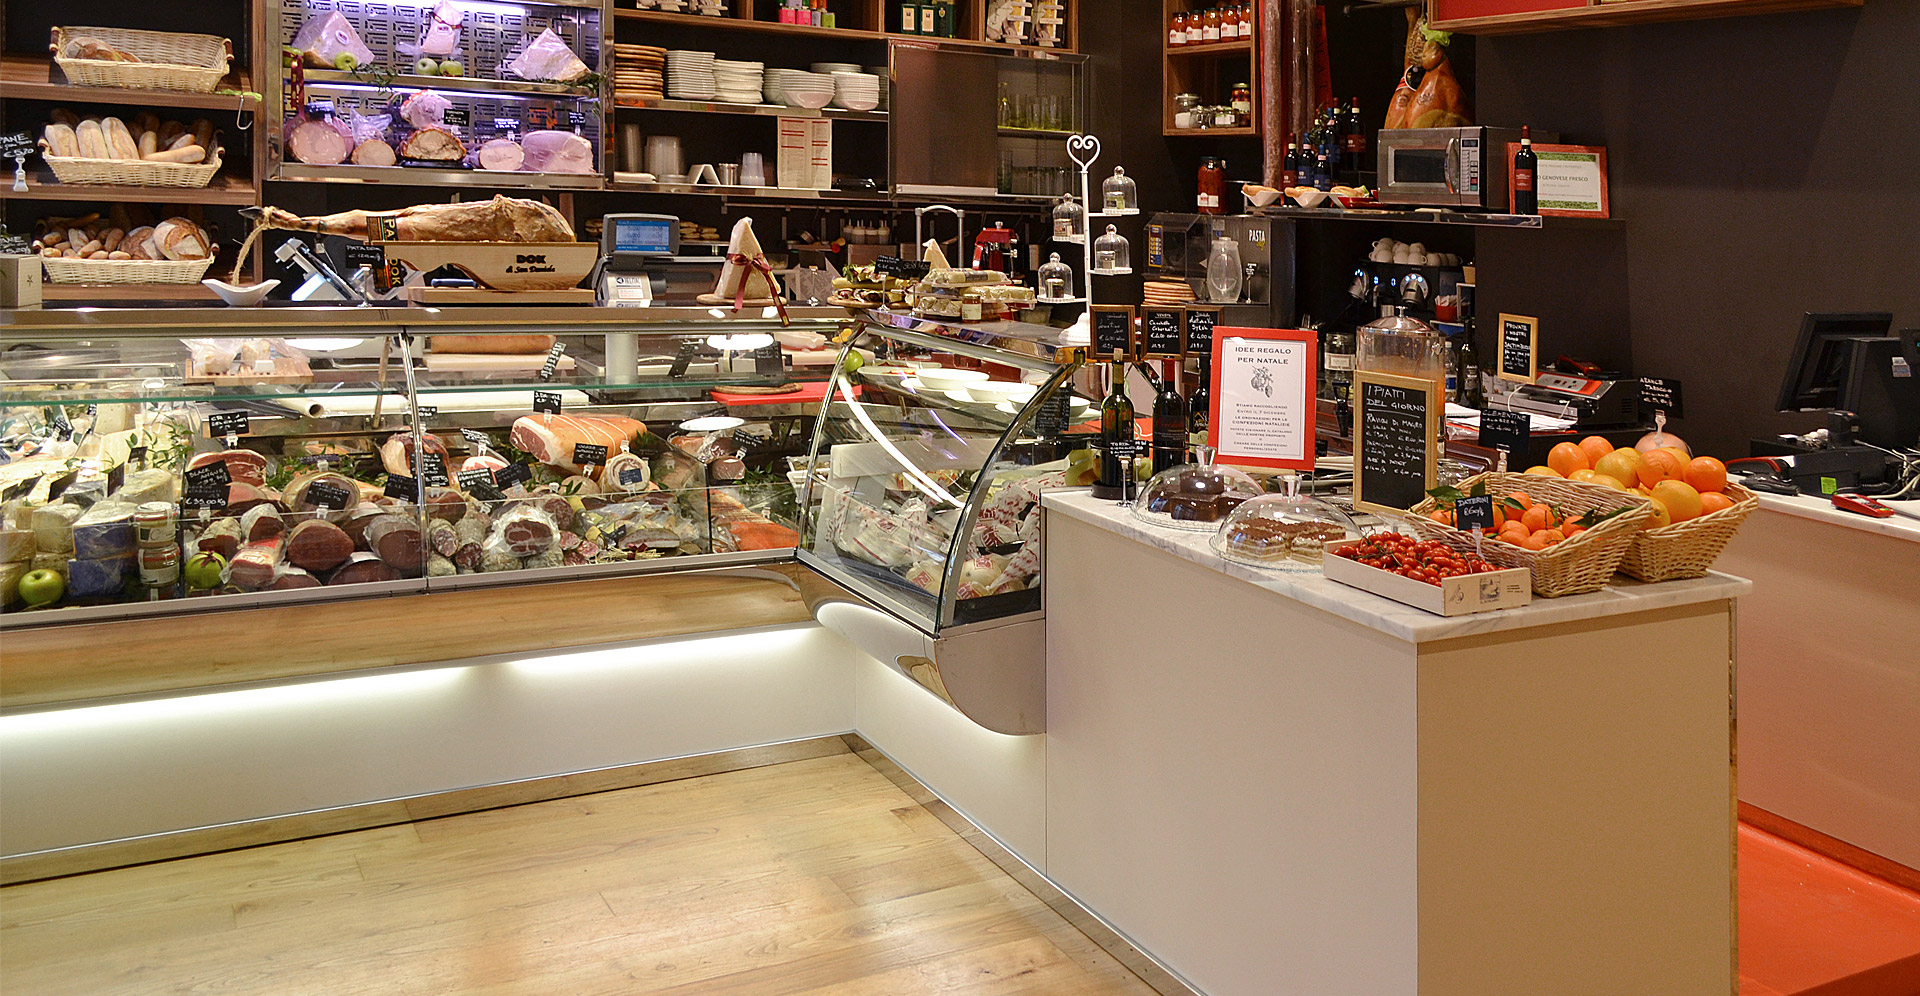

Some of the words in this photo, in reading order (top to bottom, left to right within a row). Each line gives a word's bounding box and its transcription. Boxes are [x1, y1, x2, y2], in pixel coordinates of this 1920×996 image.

[1248, 229, 1266, 242] PASTA
[516, 254, 547, 264] DOK
[529, 265, 556, 273] Daniele
[1505, 322, 1528, 331] PROVATE
[1368, 385, 1371, 396] I
[1373, 385, 1406, 400] PIATTI
[1366, 398, 1388, 407] DEL
[1390, 401, 1426, 412] GIORNO
[1482, 409, 1527, 421] CLEMENTINE
[189, 468, 210, 478] BLACK
[200, 468, 224, 480] ANGUS
